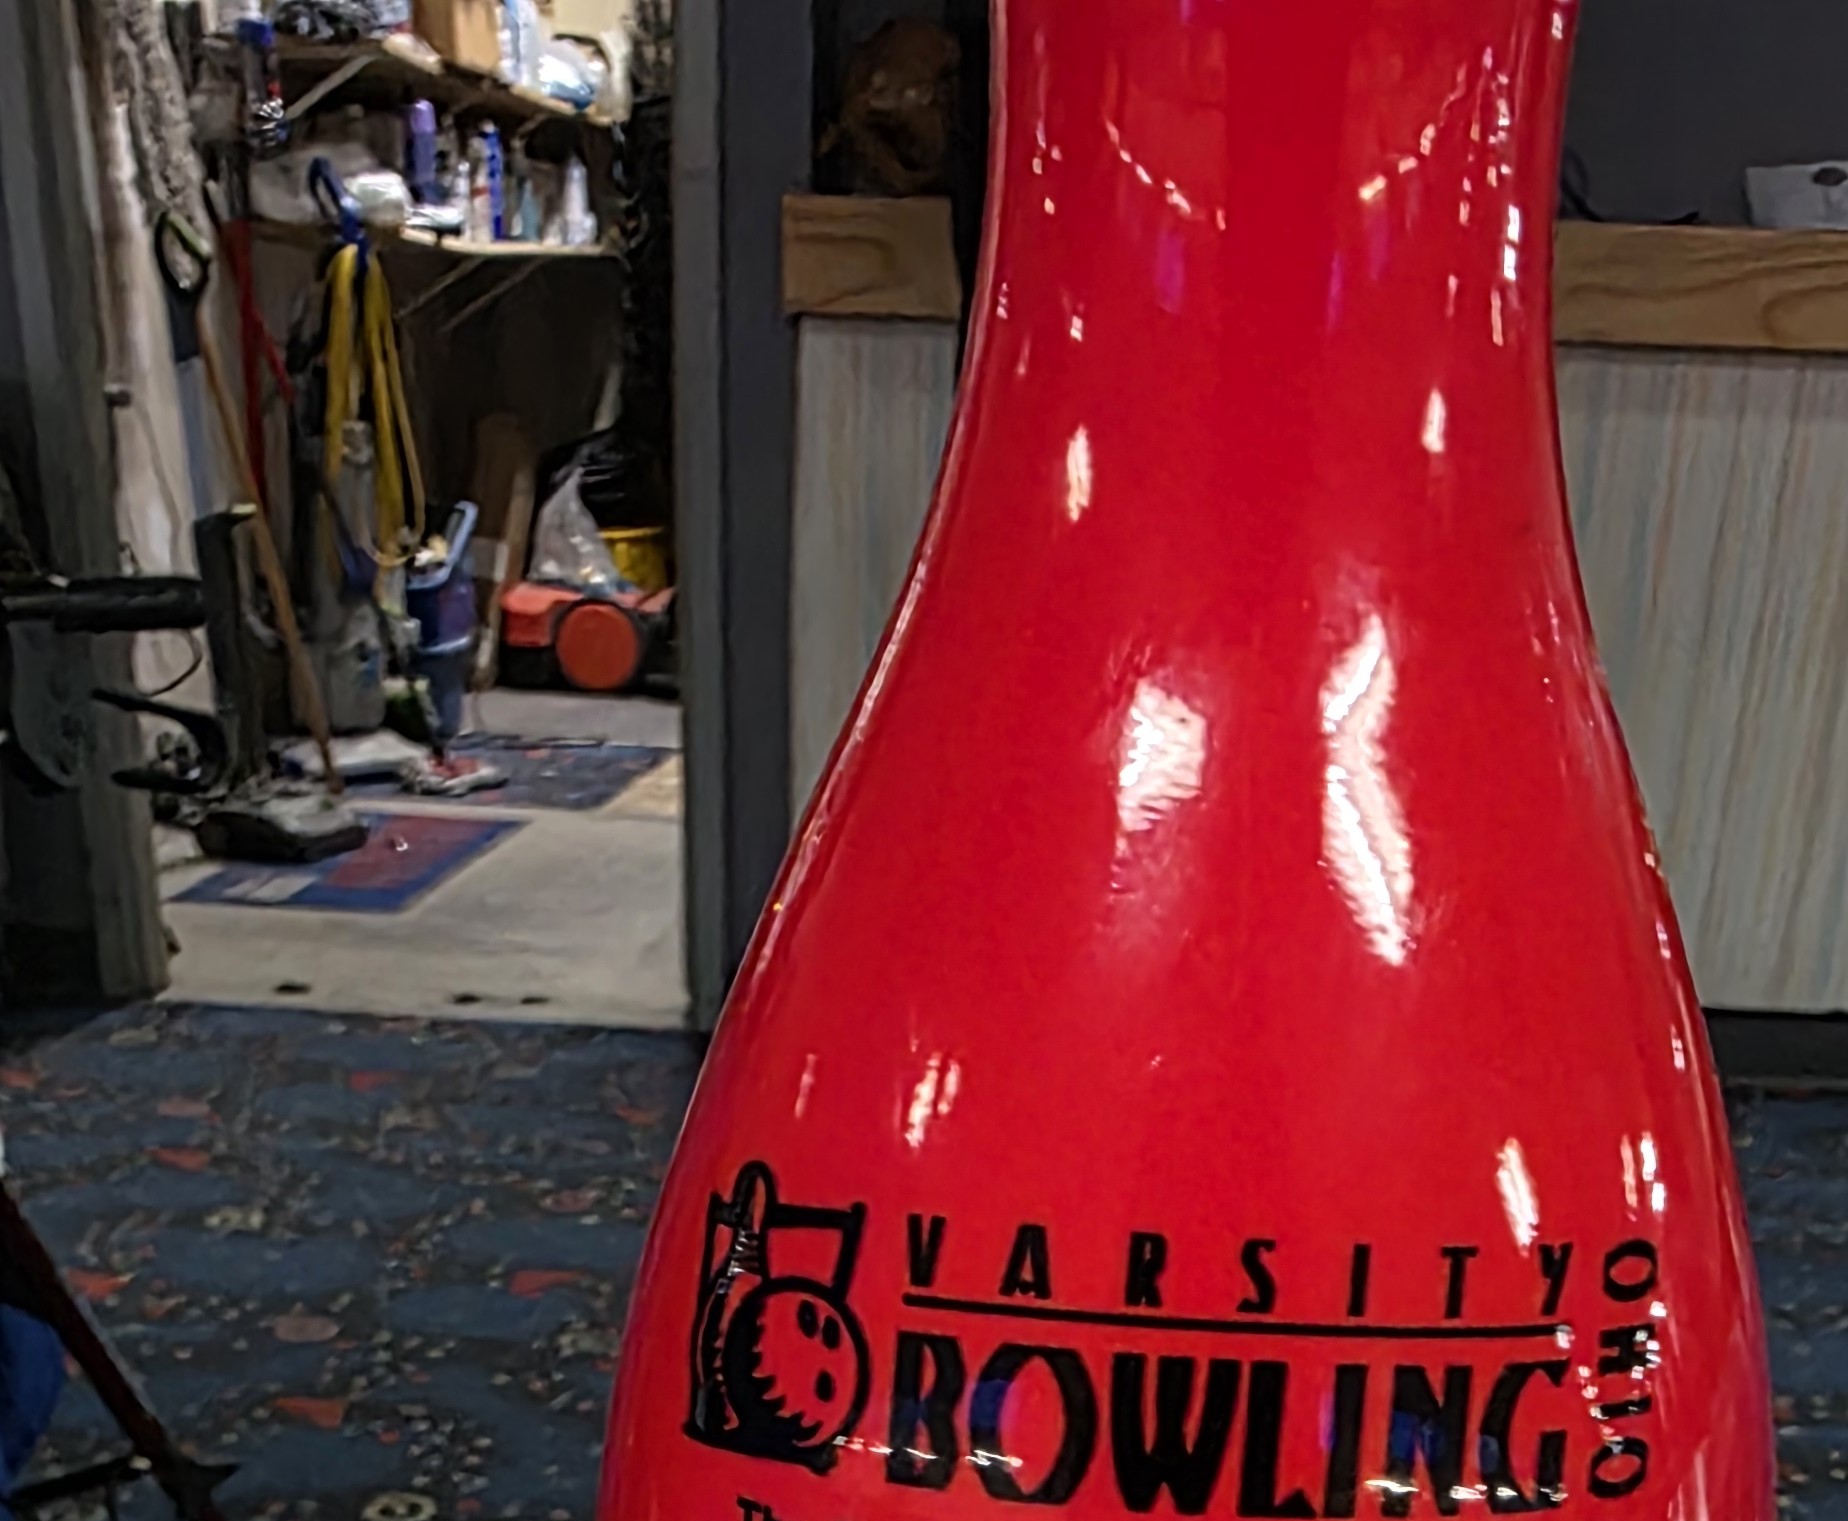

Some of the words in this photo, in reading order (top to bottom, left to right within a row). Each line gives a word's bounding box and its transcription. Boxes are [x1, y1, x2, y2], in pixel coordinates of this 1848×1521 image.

[906, 1212, 1574, 1320] VARSITY
[885, 1329, 1571, 1519] BOWLING
[1588, 1239, 1659, 1499] OHIO
